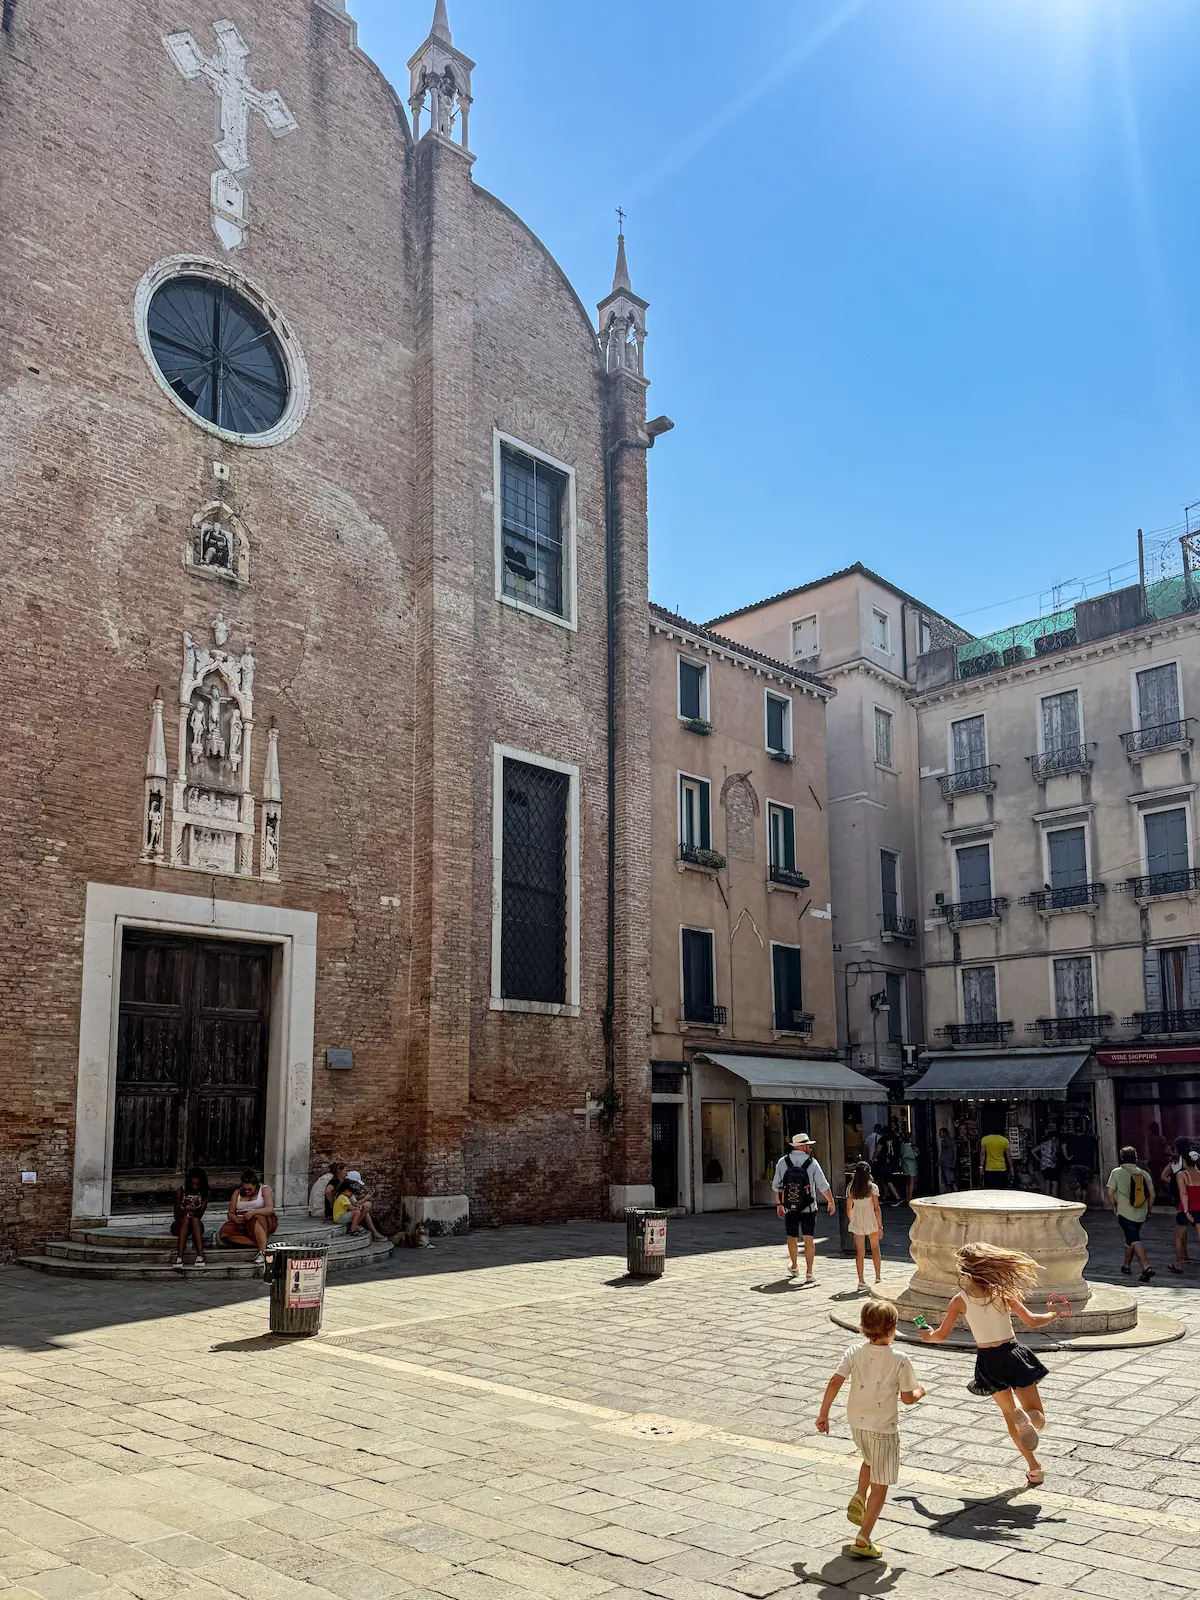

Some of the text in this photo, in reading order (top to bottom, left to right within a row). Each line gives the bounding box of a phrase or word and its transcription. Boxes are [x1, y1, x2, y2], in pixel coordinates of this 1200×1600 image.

[903, 1045, 916, 1064] T
[792, 1087, 854, 1100] PATRIZIA
[292, 1259, 323, 1269] VIETATO
